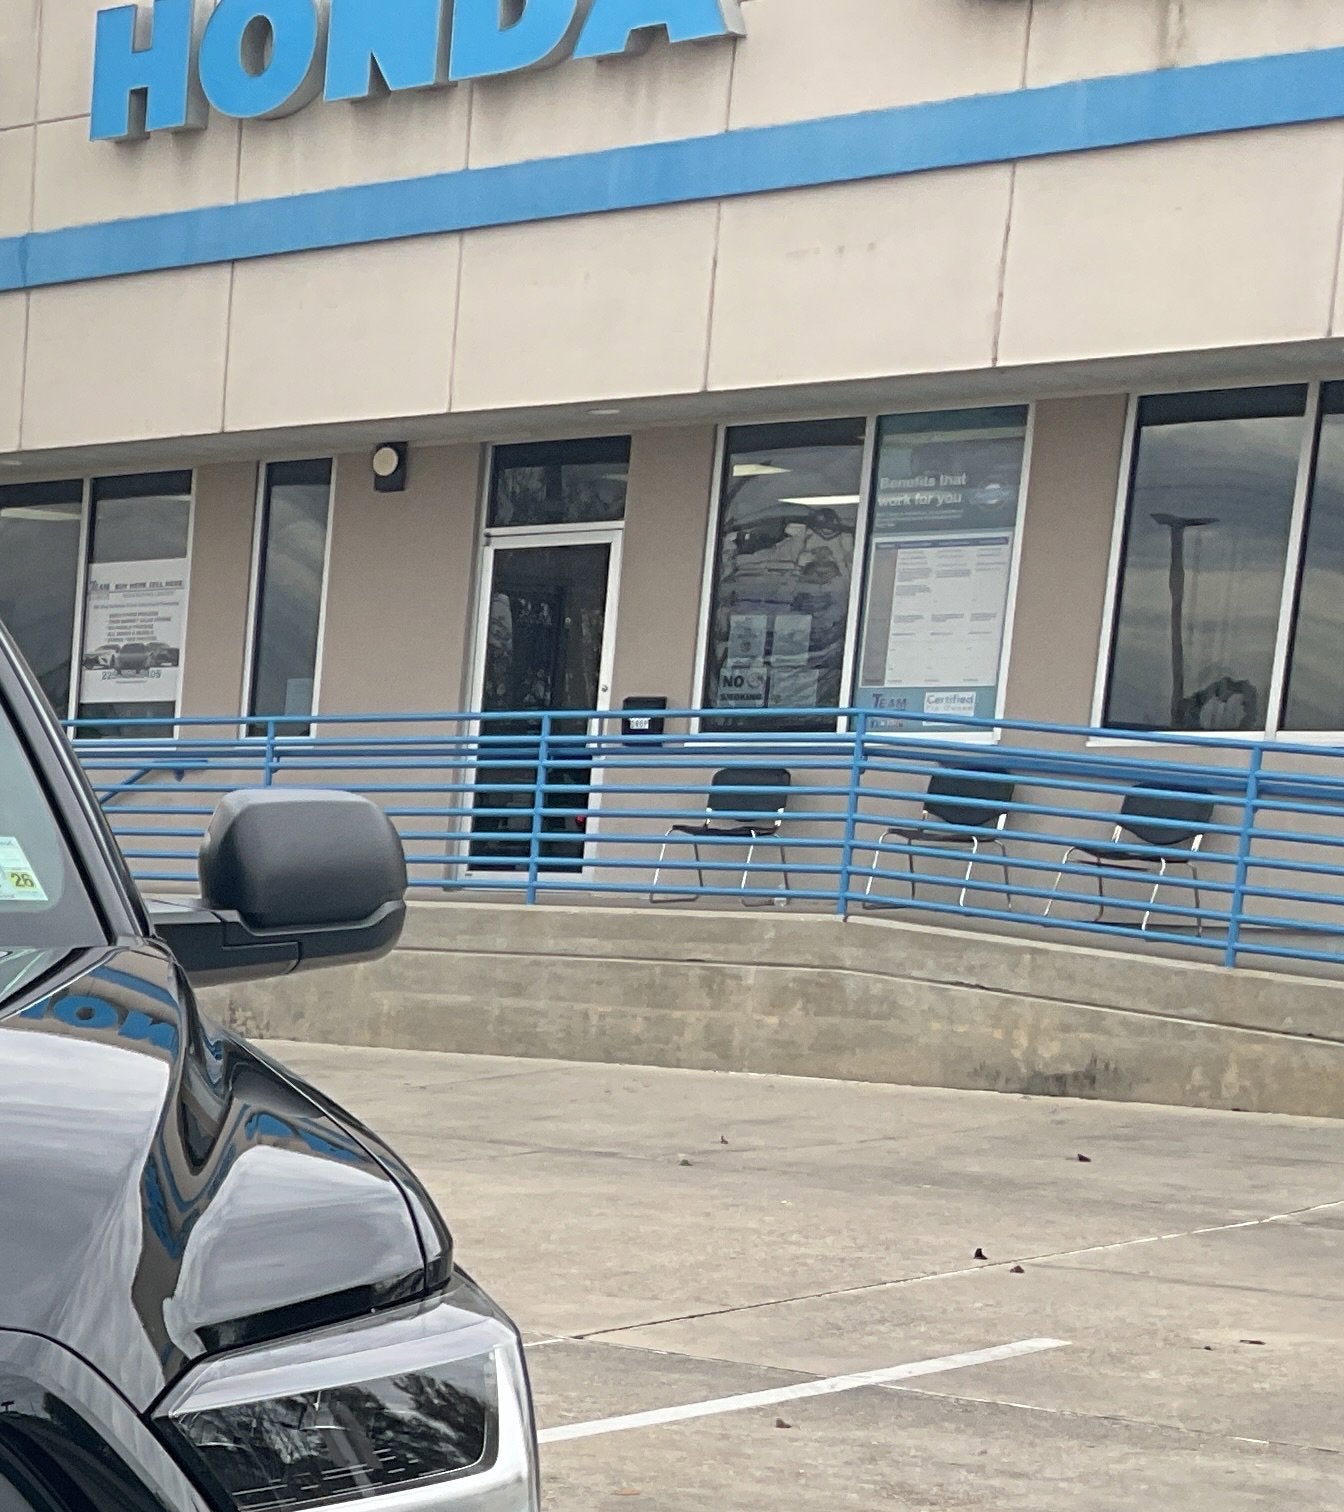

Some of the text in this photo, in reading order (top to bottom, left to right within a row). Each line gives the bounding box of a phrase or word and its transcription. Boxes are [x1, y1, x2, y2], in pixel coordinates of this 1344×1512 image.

[880, 473, 967, 489] Benefits that
[877, 494, 910, 506] work
[915, 493, 934, 505] for
[937, 493, 962, 507] you
[722, 675, 744, 688] NO
[926, 693, 974, 705] Certified
[10, 872, 36, 888] 26
